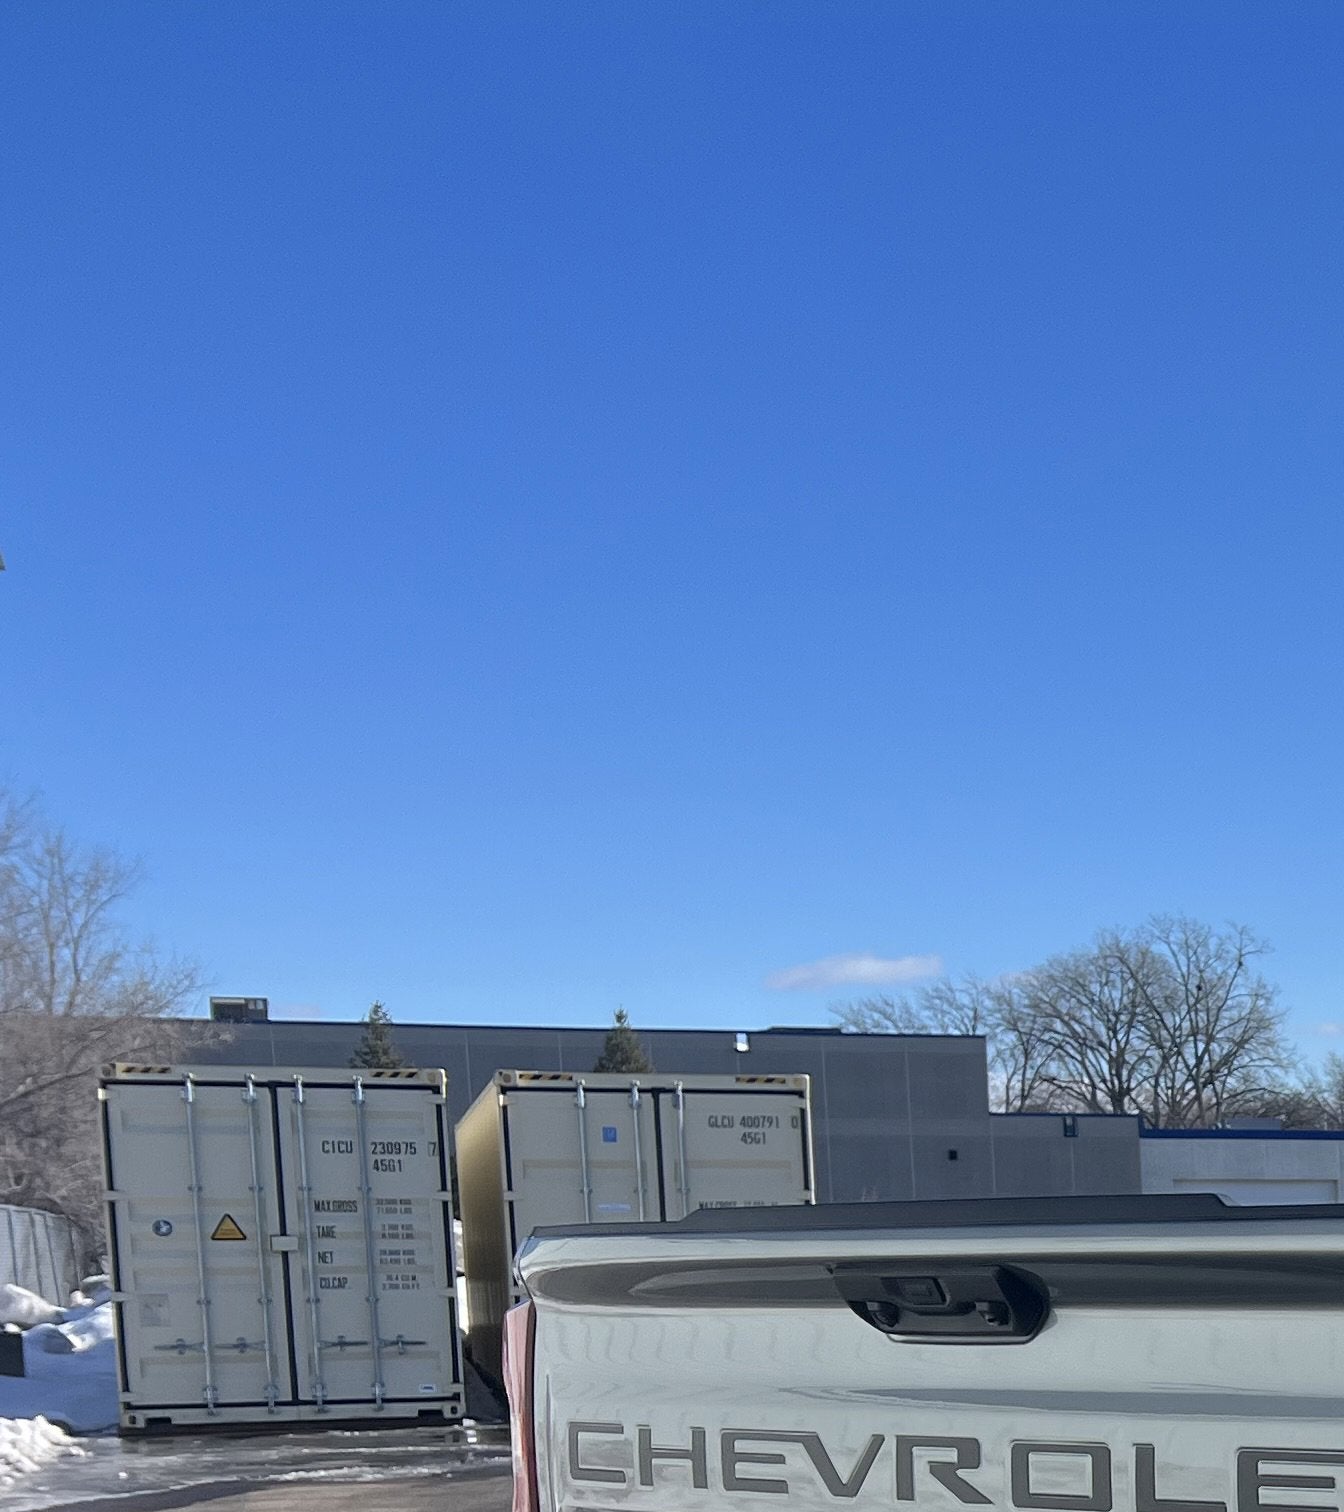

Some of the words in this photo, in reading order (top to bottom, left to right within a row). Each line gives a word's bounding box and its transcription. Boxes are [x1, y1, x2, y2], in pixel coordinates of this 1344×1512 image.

[708, 1116, 734, 1128] GLCU
[739, 1116, 780, 1129] 400791
[740, 1132, 766, 1145] 45G1
[322, 1140, 353, 1154] CICU
[371, 1142, 417, 1155] 230975
[372, 1159, 403, 1172] 45G1
[316, 1225, 336, 1239] TARE
[318, 1251, 334, 1264] NET
